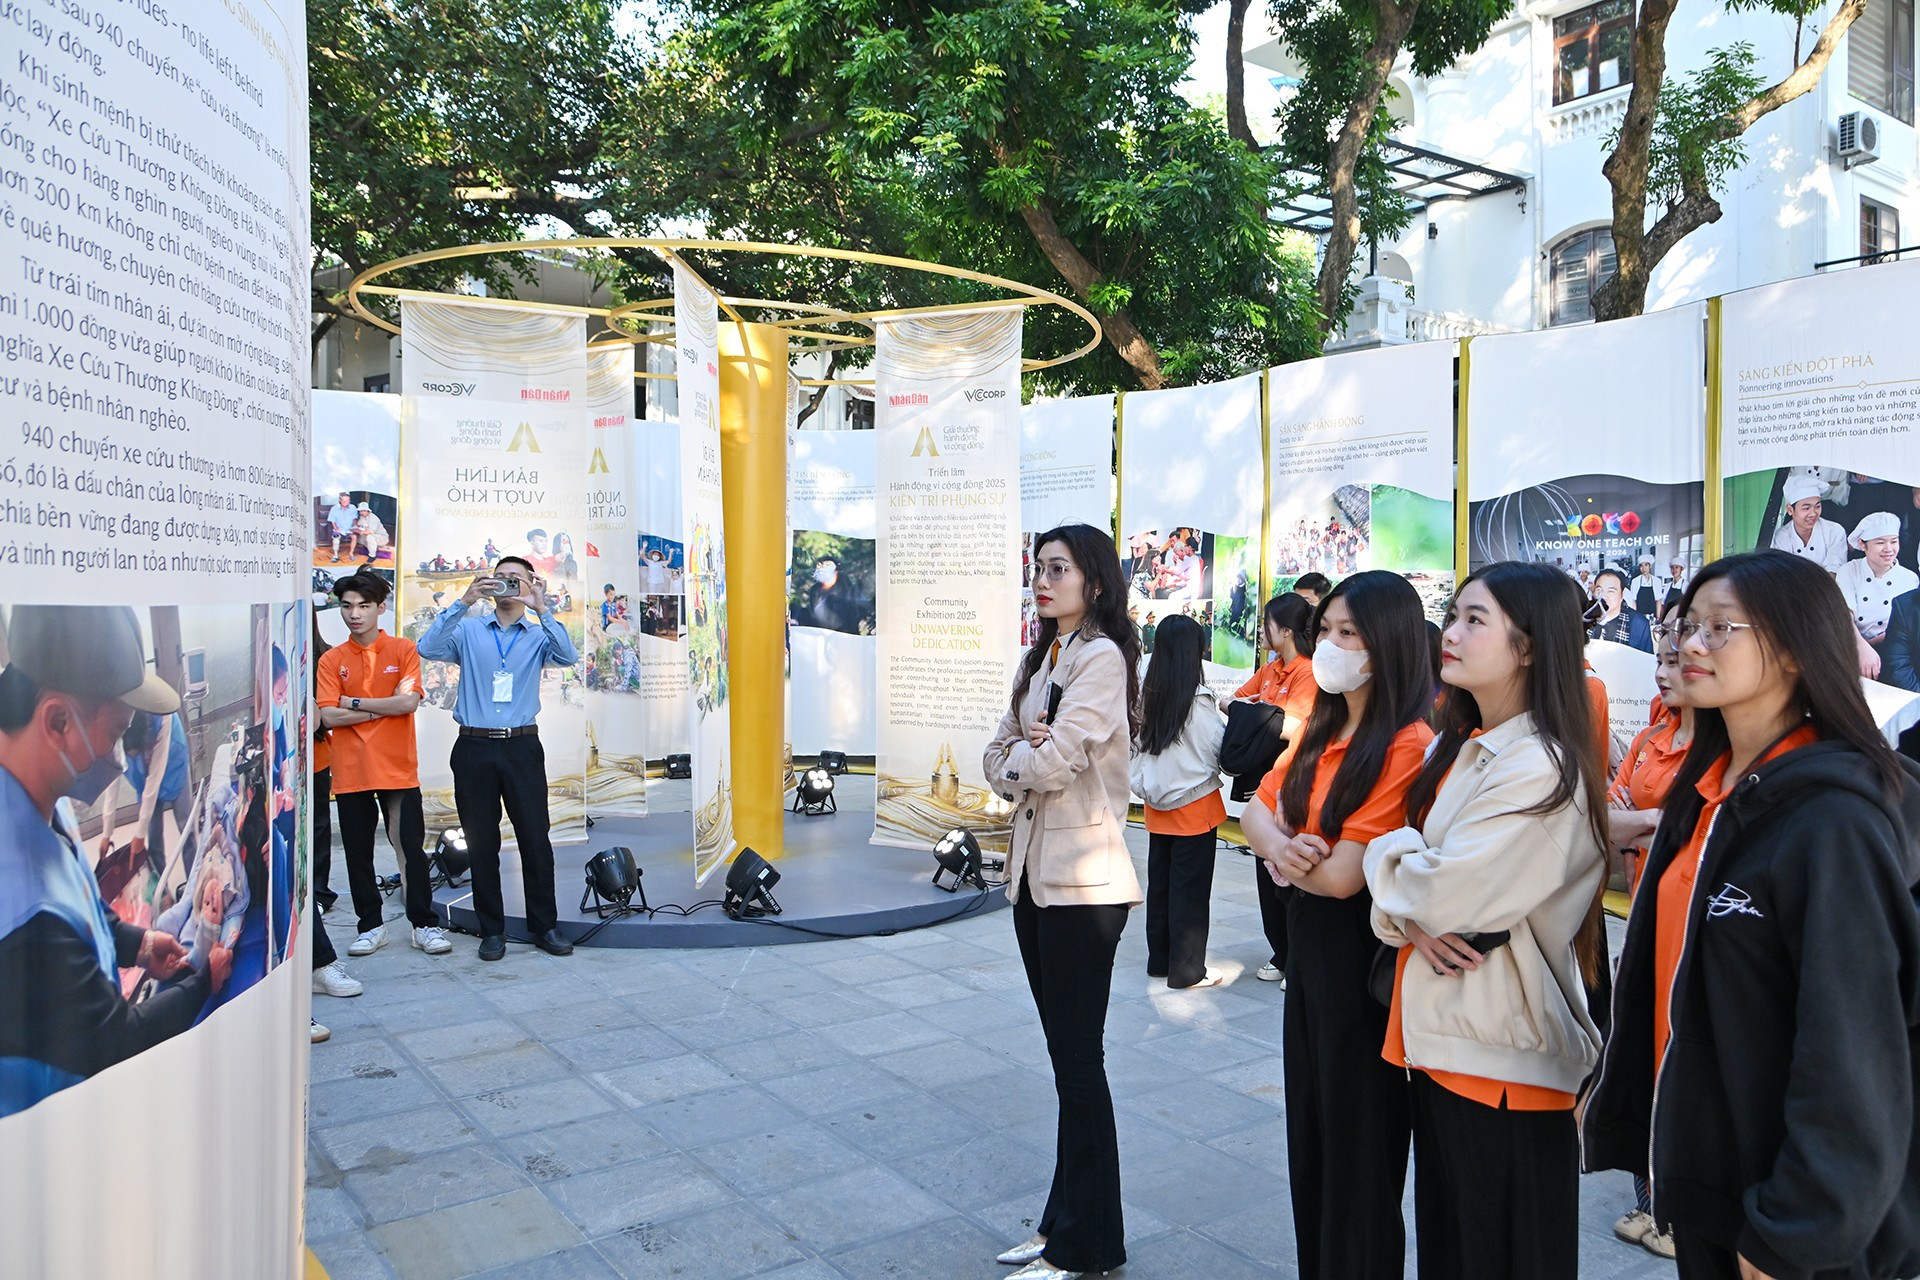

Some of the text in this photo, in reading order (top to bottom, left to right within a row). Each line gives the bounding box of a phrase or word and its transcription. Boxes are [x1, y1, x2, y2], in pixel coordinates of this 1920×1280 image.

[27, 9, 106, 76] lay động.
[60, 0, 90, 27] sau
[95, 12, 123, 48] 940
[127, 38, 179, 83] chuyến
[182, 23, 197, 48] no
[199, 32, 214, 64] life
[215, 48, 233, 80] left
[234, 64, 263, 108] behind
[19, 50, 181, 155] Khi sinh mệnh bị thử
[79, 121, 111, 156] Cứu
[115, 138, 176, 192] Thương
[41, 145, 204, 236] cho hàng nghìn người
[34, 177, 180, 257] 300 km không chỉ
[20, 216, 53, 244] quê
[57, 224, 117, 272] hương,
[20, 255, 197, 337] Từ trái tim nhân ái, dự
[23, 297, 186, 368] 1.000 đồng vừa giúp
[48, 343, 178, 401] Xe Cứu Thương
[1738, 351, 1874, 382] SÁNG KIẾN ĐỘT PHÁ
[1784, 375, 1834, 388] innovations
[23, 378, 191, 433] và bệnh nhân nghèo.
[22, 421, 214, 482] 940 chuyến xe cứu thương
[928, 467, 965, 477] Triển lãm
[25, 462, 204, 510] đó là dấu chân của lòng
[889, 479, 1006, 492] Hành động vì cộng đồng 2025
[889, 492, 916, 507] KIÊN
[920, 491, 938, 507] TRÌ
[941, 492, 986, 508] PHỤNG
[989, 492, 1007, 507] SỰ
[37, 501, 200, 543] bền vững đang được
[1535, 534, 1670, 550] KNOW ONE TEACH ONE
[23, 541, 198, 573] tình người lan tỏa như
[916, 610, 977, 620] Exhibition 2025
[924, 597, 969, 608] Community
[910, 623, 984, 636] UNWAVERING
[912, 638, 981, 650] DEDICATION
[1616, 697, 1639, 706] thưởng
